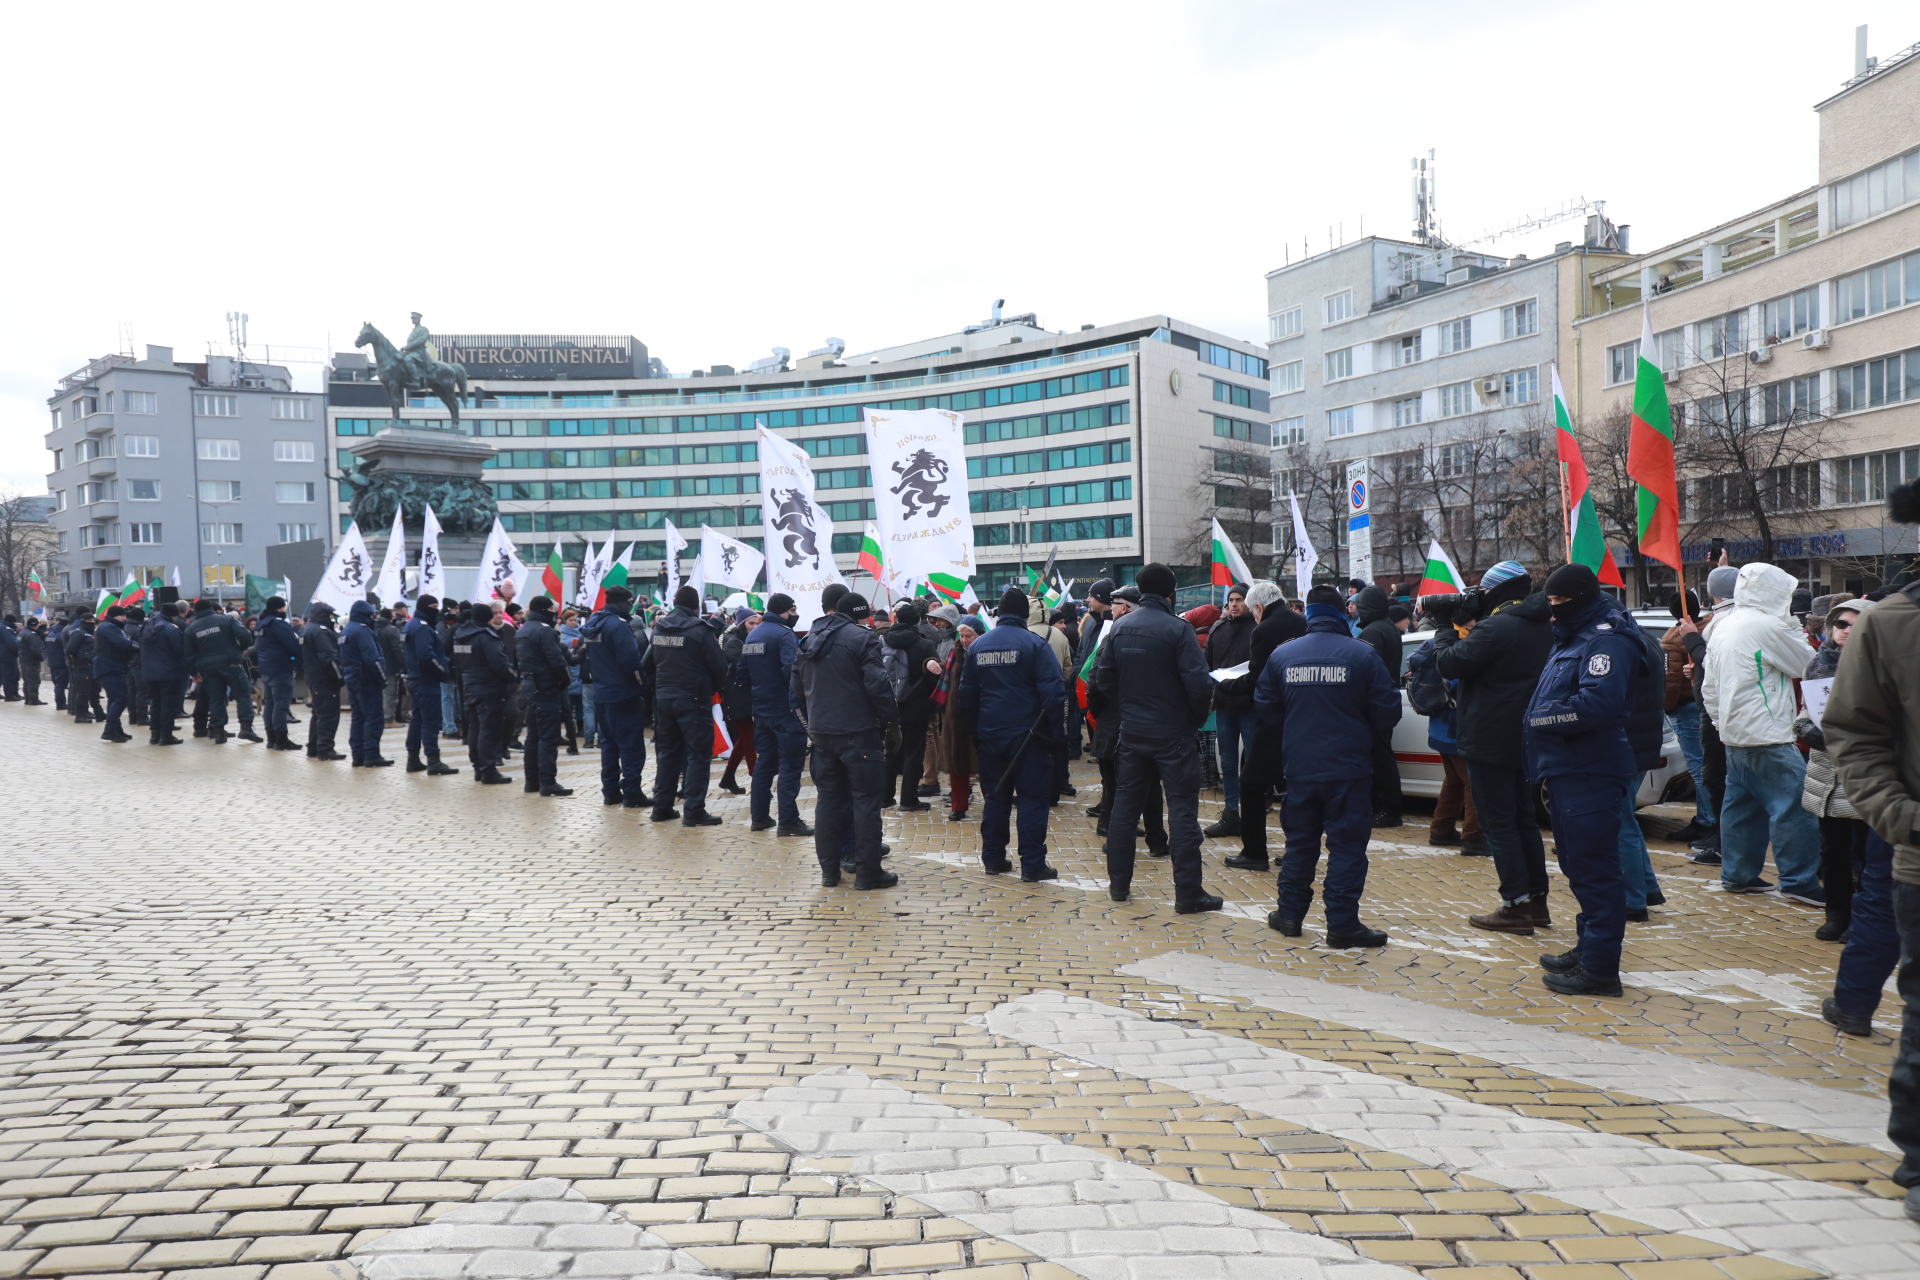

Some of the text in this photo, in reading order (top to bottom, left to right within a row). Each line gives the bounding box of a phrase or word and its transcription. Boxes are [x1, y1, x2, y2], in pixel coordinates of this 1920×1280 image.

[1348, 464, 1367, 481] ЗОНА
[890, 517, 962, 542] ВЪЗРАЖДАНЕ
[976, 650, 1018, 666] SECURITY POLICE
[1285, 666, 1347, 683] SECURITY POLICE
[1530, 712, 1579, 727] SECURITY POLICE
